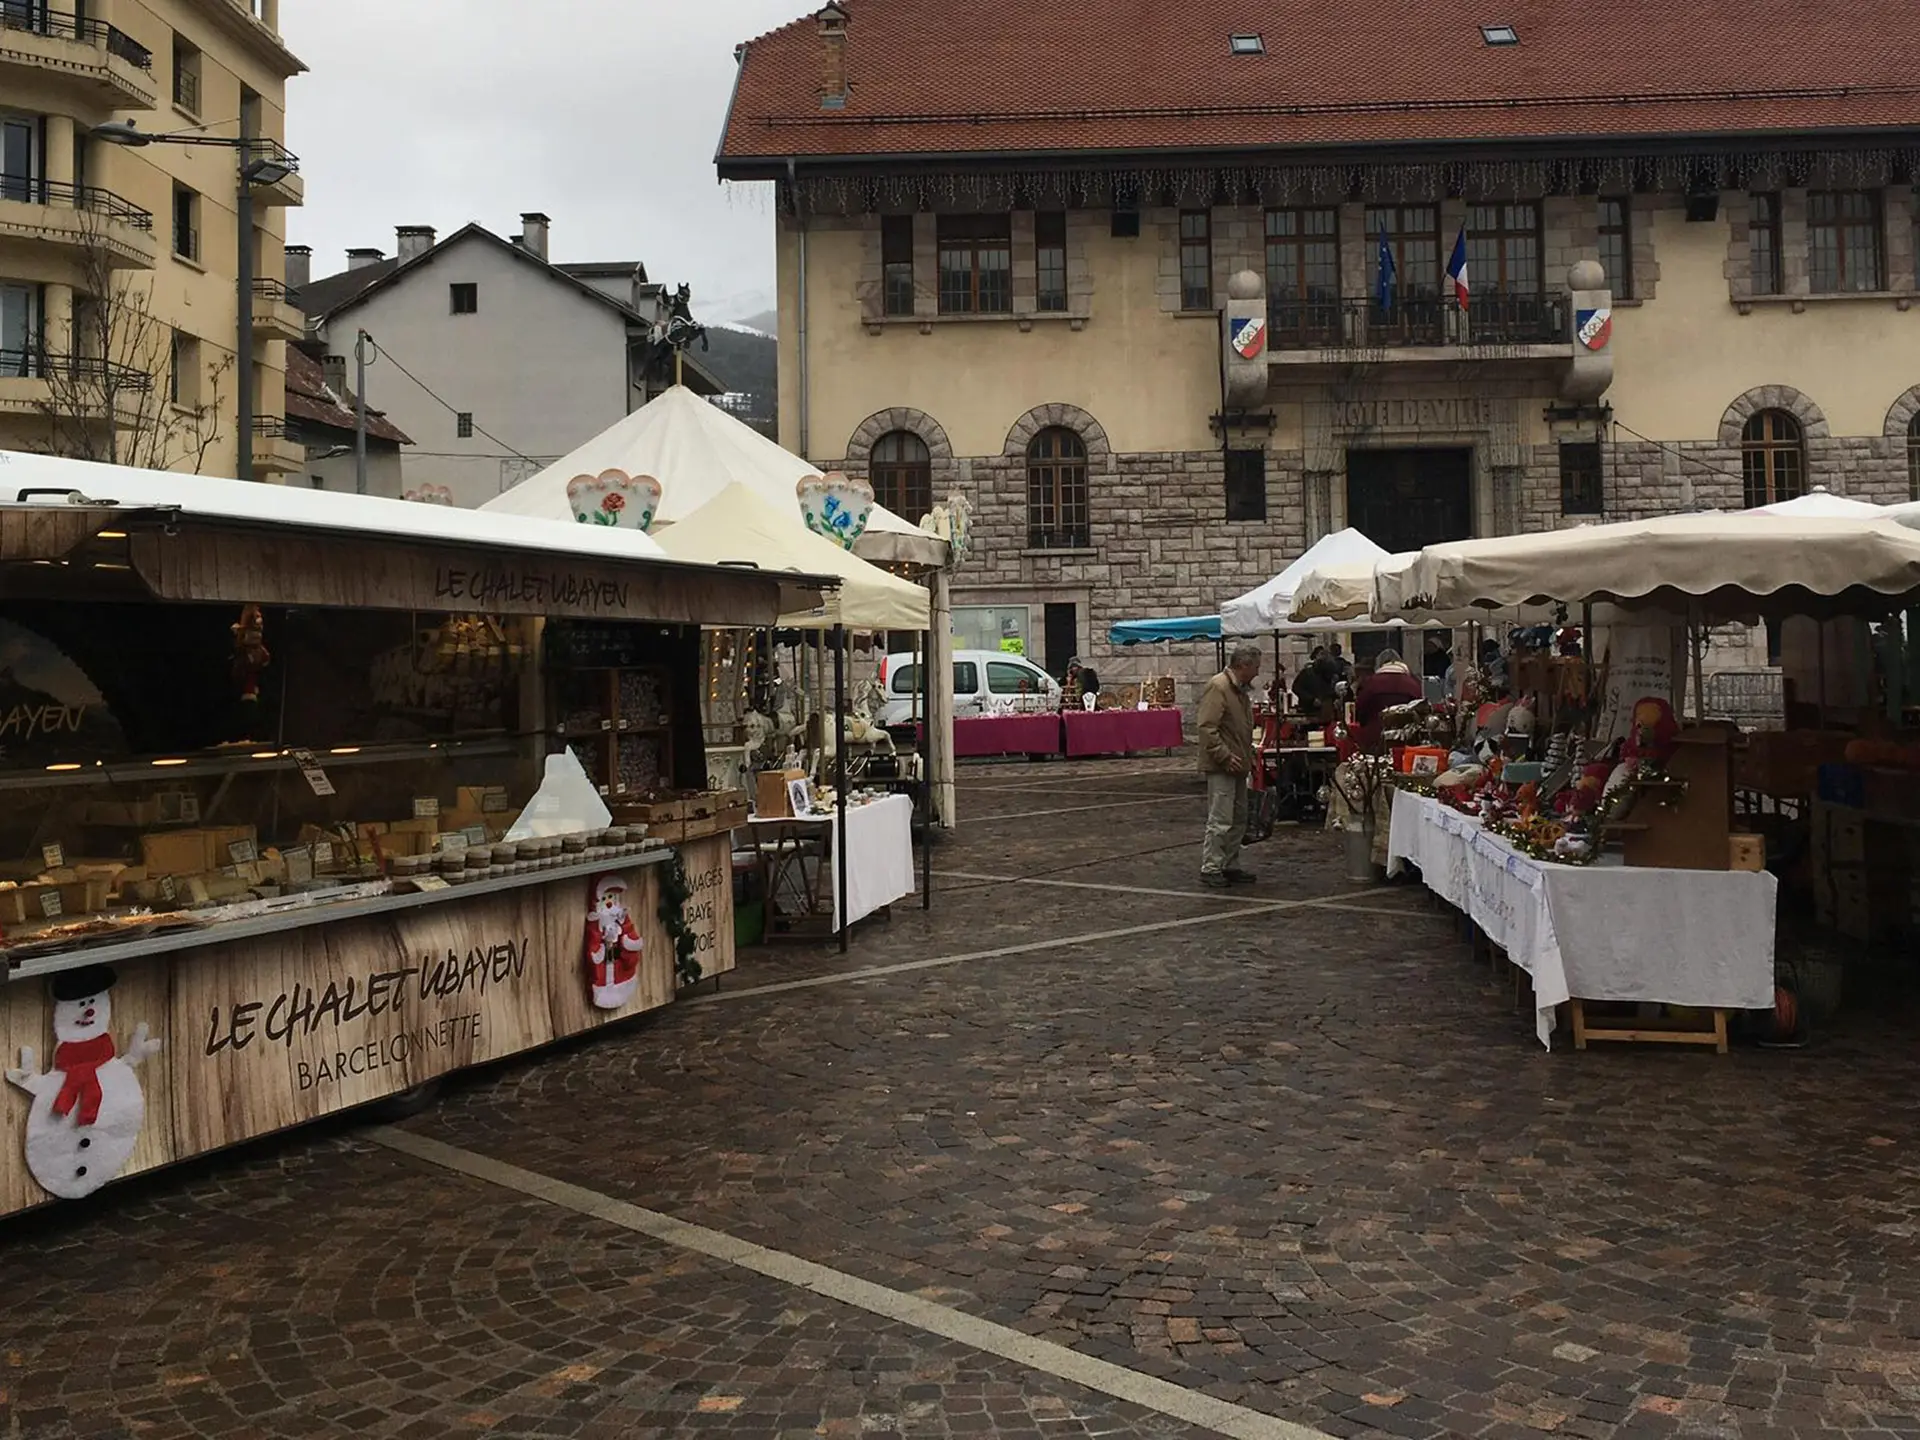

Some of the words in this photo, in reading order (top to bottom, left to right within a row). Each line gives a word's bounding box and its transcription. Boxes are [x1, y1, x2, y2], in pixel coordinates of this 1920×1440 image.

[434, 566, 466, 599] LE
[468, 569, 549, 607] CHALET
[551, 573, 630, 611] UBAYEN
[0, 702, 87, 741] AYEN
[685, 867, 724, 893] MAGES
[205, 1001, 263, 1056] LE
[264, 967, 419, 1048] CHALET
[419, 937, 528, 1002] UBAYEN
[297, 1012, 481, 1091] BARCELONNETTE
